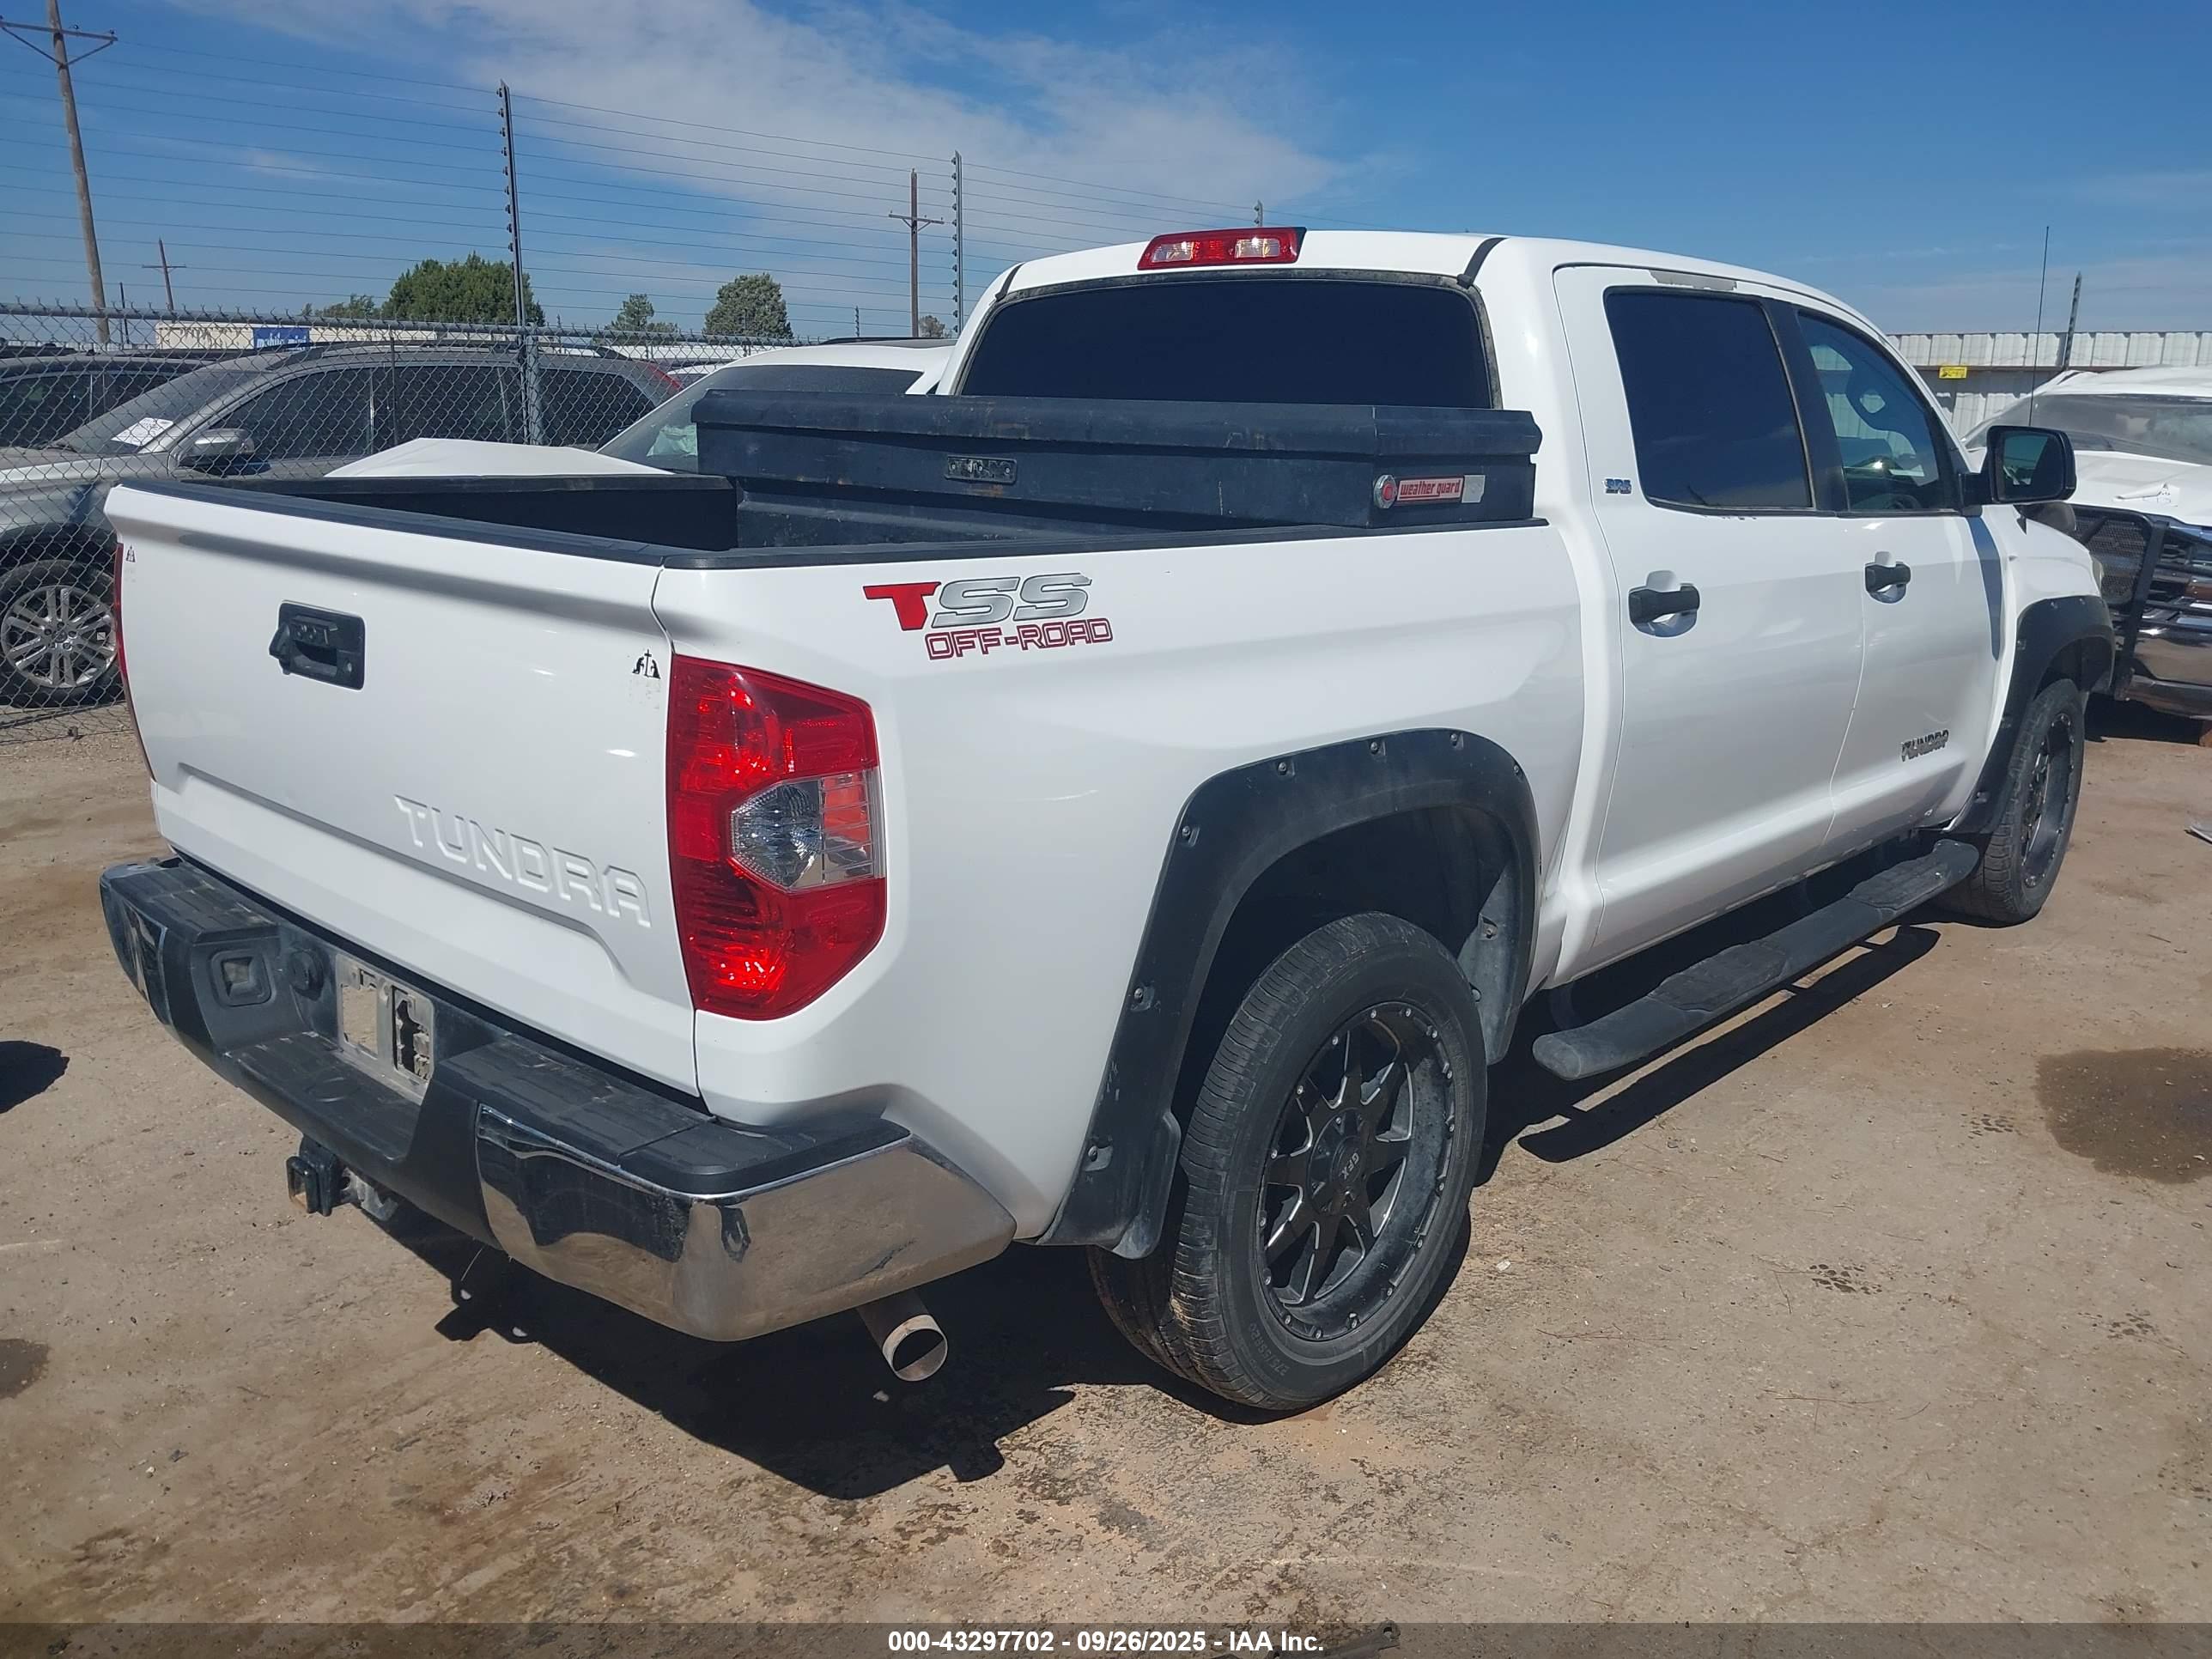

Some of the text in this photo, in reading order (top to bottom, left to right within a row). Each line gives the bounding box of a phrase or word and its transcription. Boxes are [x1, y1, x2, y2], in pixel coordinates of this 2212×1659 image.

[1400, 479, 1462, 496] weather guard
[924, 617, 1115, 660] OFF-ROAD
[1900, 729, 1949, 763] TUNDRA
[393, 793, 652, 928] TUNDRA
